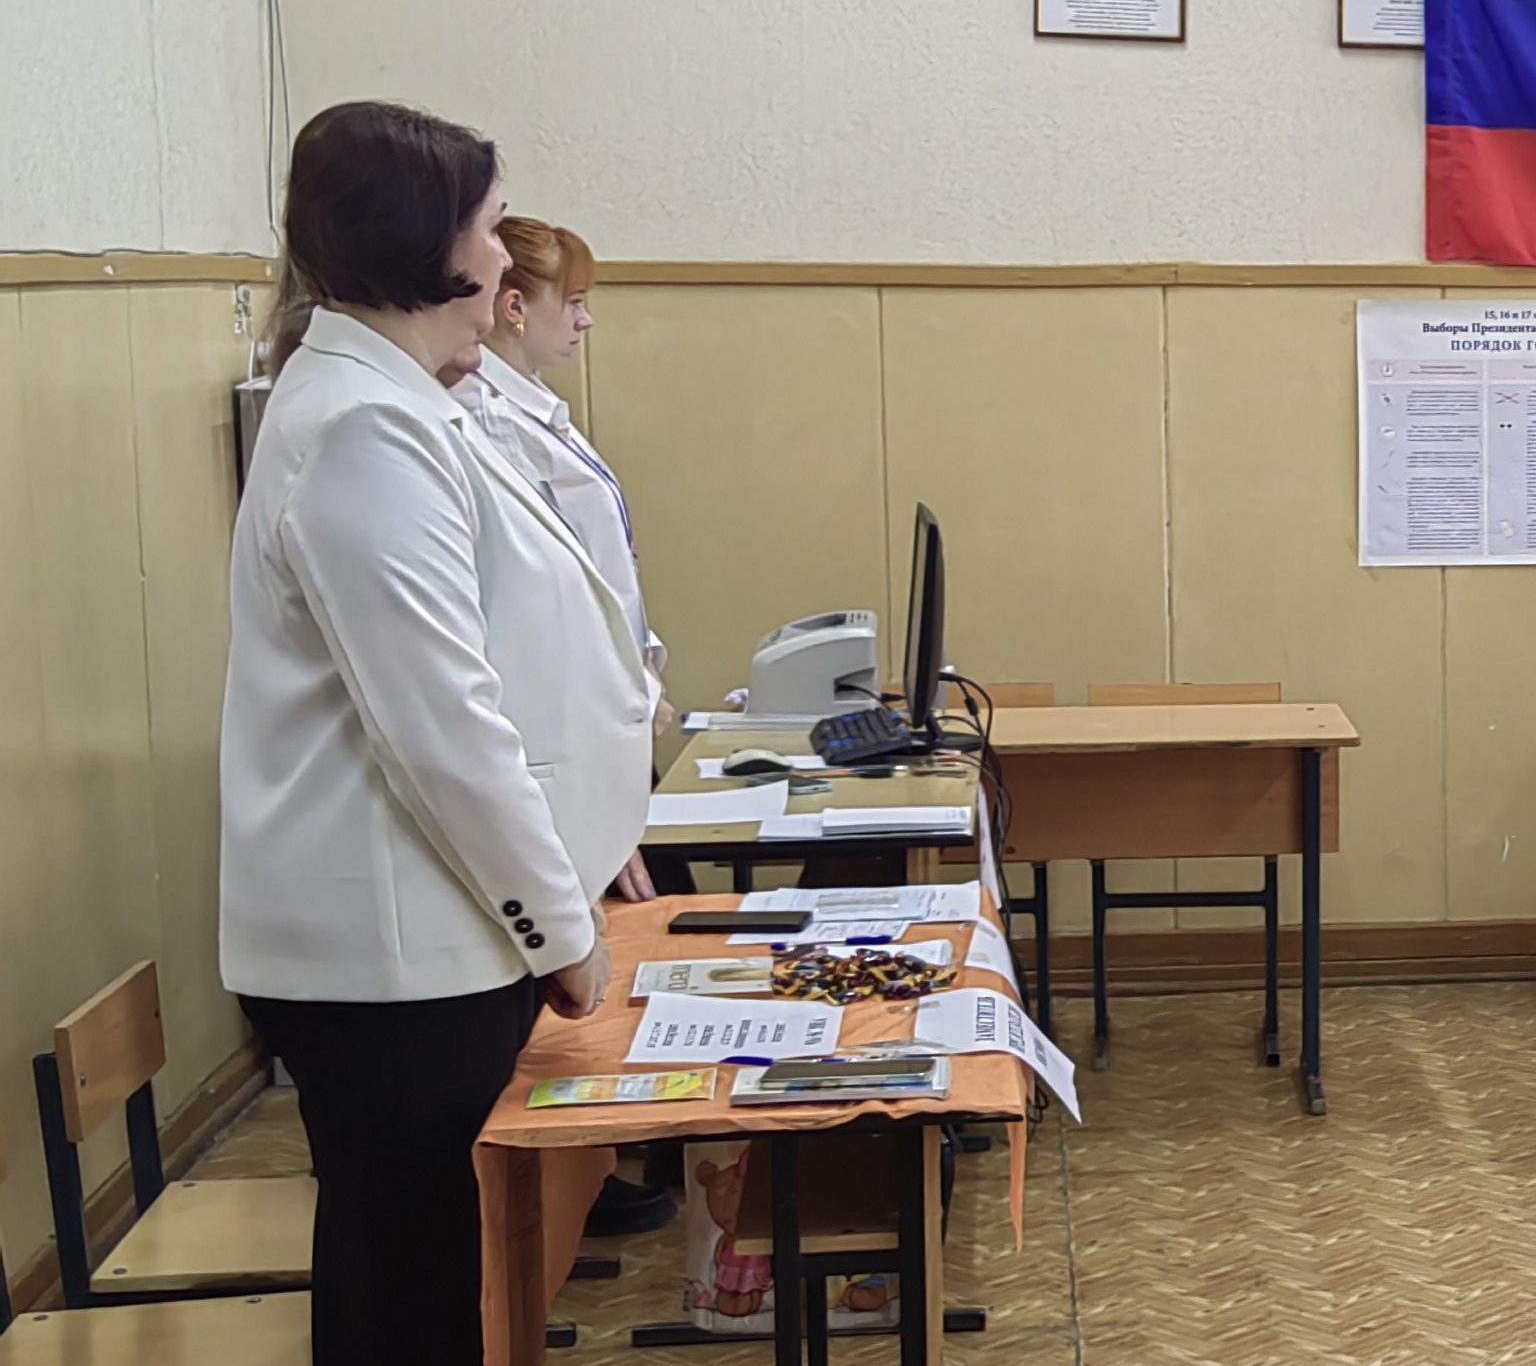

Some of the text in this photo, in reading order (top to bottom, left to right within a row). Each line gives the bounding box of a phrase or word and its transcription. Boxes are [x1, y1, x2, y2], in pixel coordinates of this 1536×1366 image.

[1500, 311, 1510, 319] 16
[1521, 311, 1532, 319] 17
[1422, 322, 1469, 335] Выборы
[1471, 322, 1536, 335] Президента
[1451, 339, 1521, 351] ПОРЯДОК
